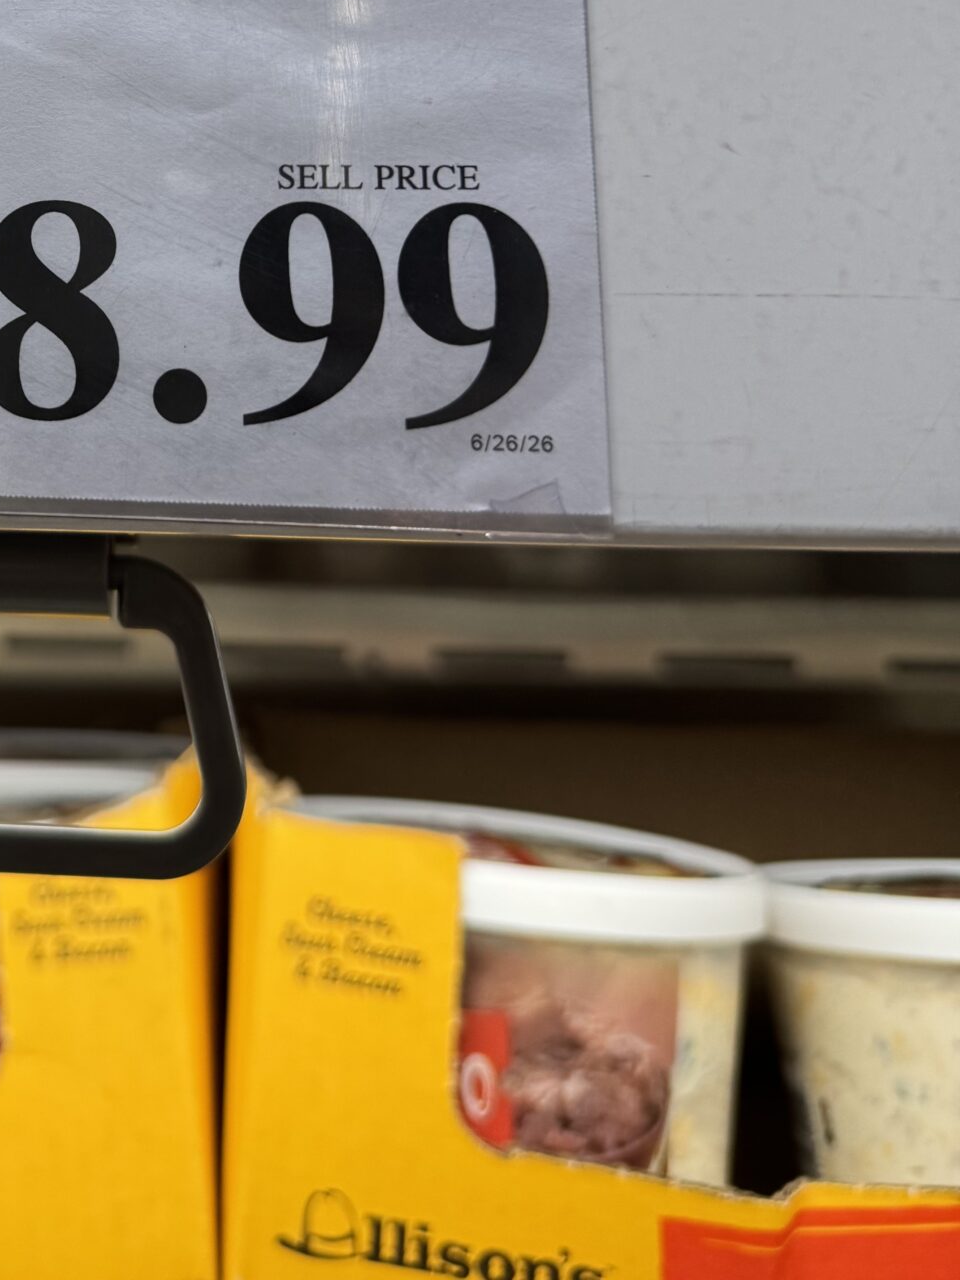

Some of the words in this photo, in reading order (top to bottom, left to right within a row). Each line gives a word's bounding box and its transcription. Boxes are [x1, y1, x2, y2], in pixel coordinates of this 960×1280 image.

[277, 165, 363, 191] SELL
[374, 165, 480, 191] PRICE
[470, 433, 554, 453] 6/26/26
